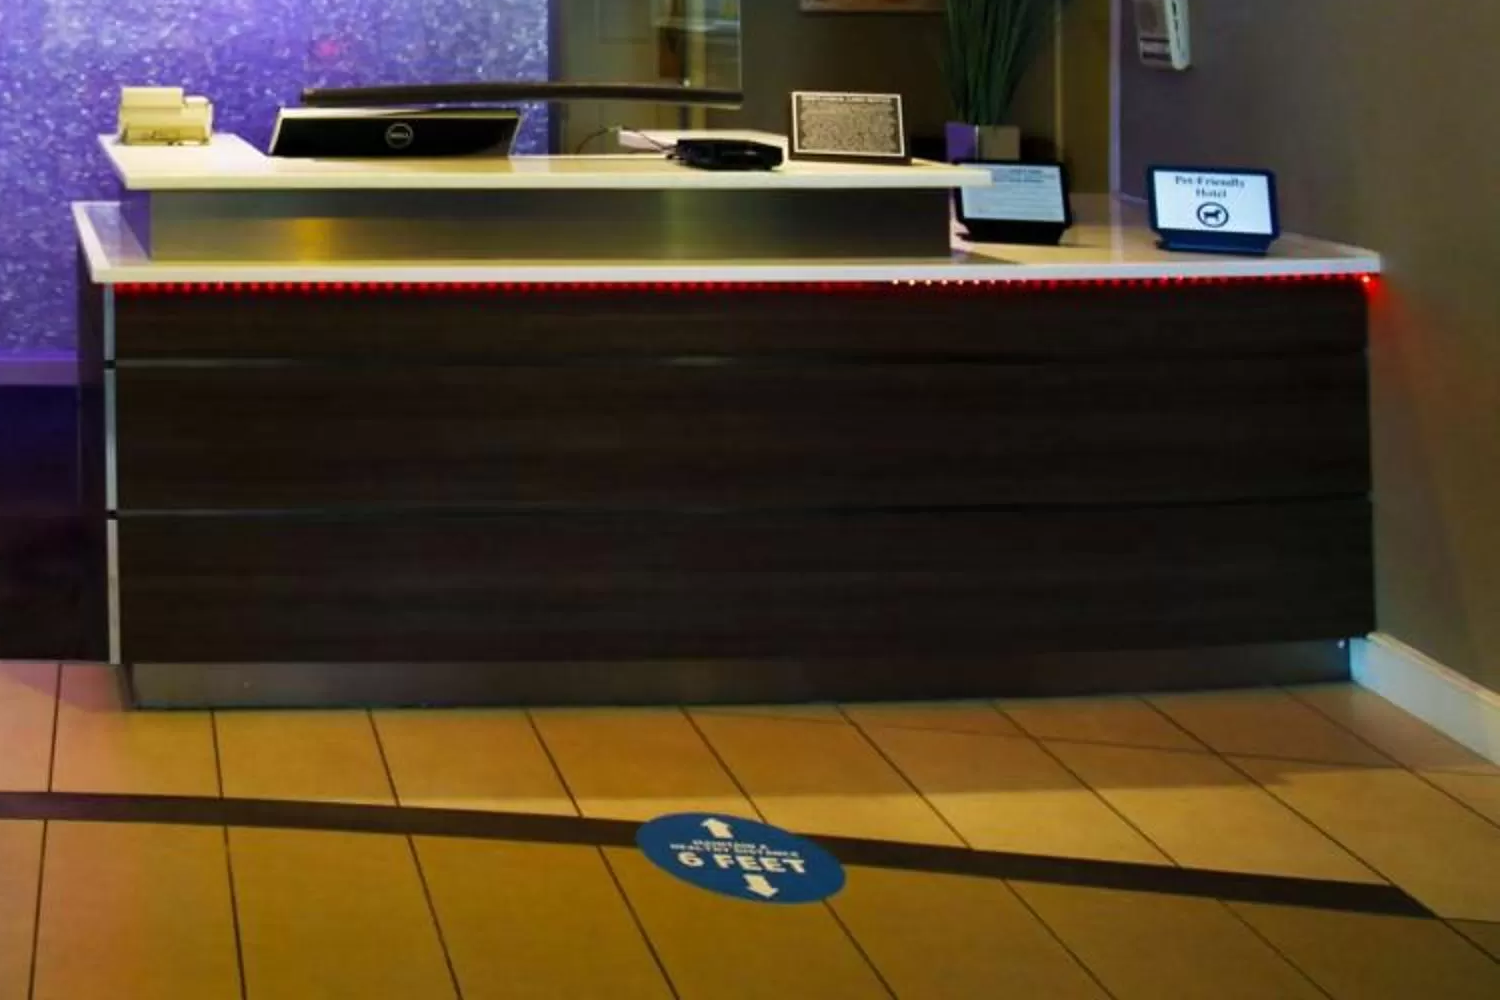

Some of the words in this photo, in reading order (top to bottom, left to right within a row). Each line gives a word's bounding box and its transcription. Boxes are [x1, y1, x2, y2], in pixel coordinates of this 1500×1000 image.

[1196, 188, 1227, 199] Hotel
[677, 851, 705, 867] 6
[712, 853, 805, 873] FEET
